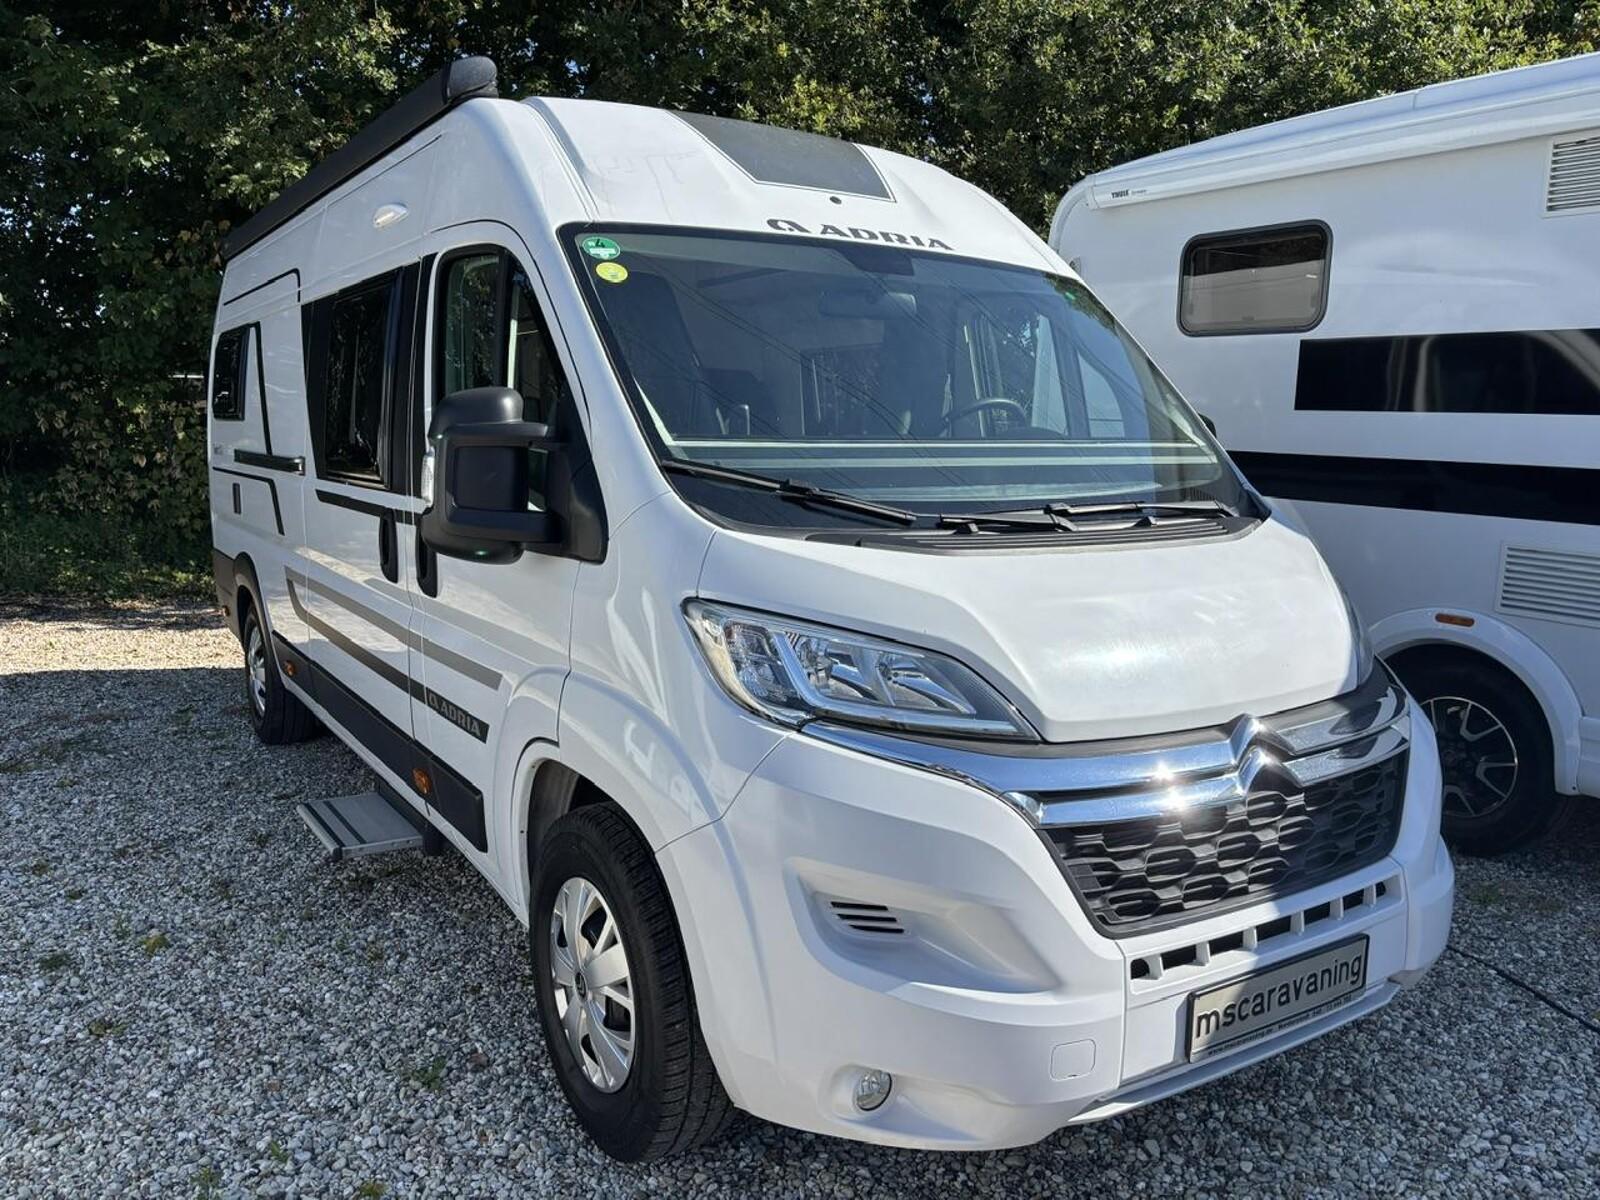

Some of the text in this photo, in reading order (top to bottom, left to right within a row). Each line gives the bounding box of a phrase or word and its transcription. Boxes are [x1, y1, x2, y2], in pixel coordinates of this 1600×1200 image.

[595, 238, 605, 248] 4
[820, 223, 956, 251] ADRIA
[440, 700, 481, 737] ADRIA
[1196, 954, 1362, 1039] mscaravaning
